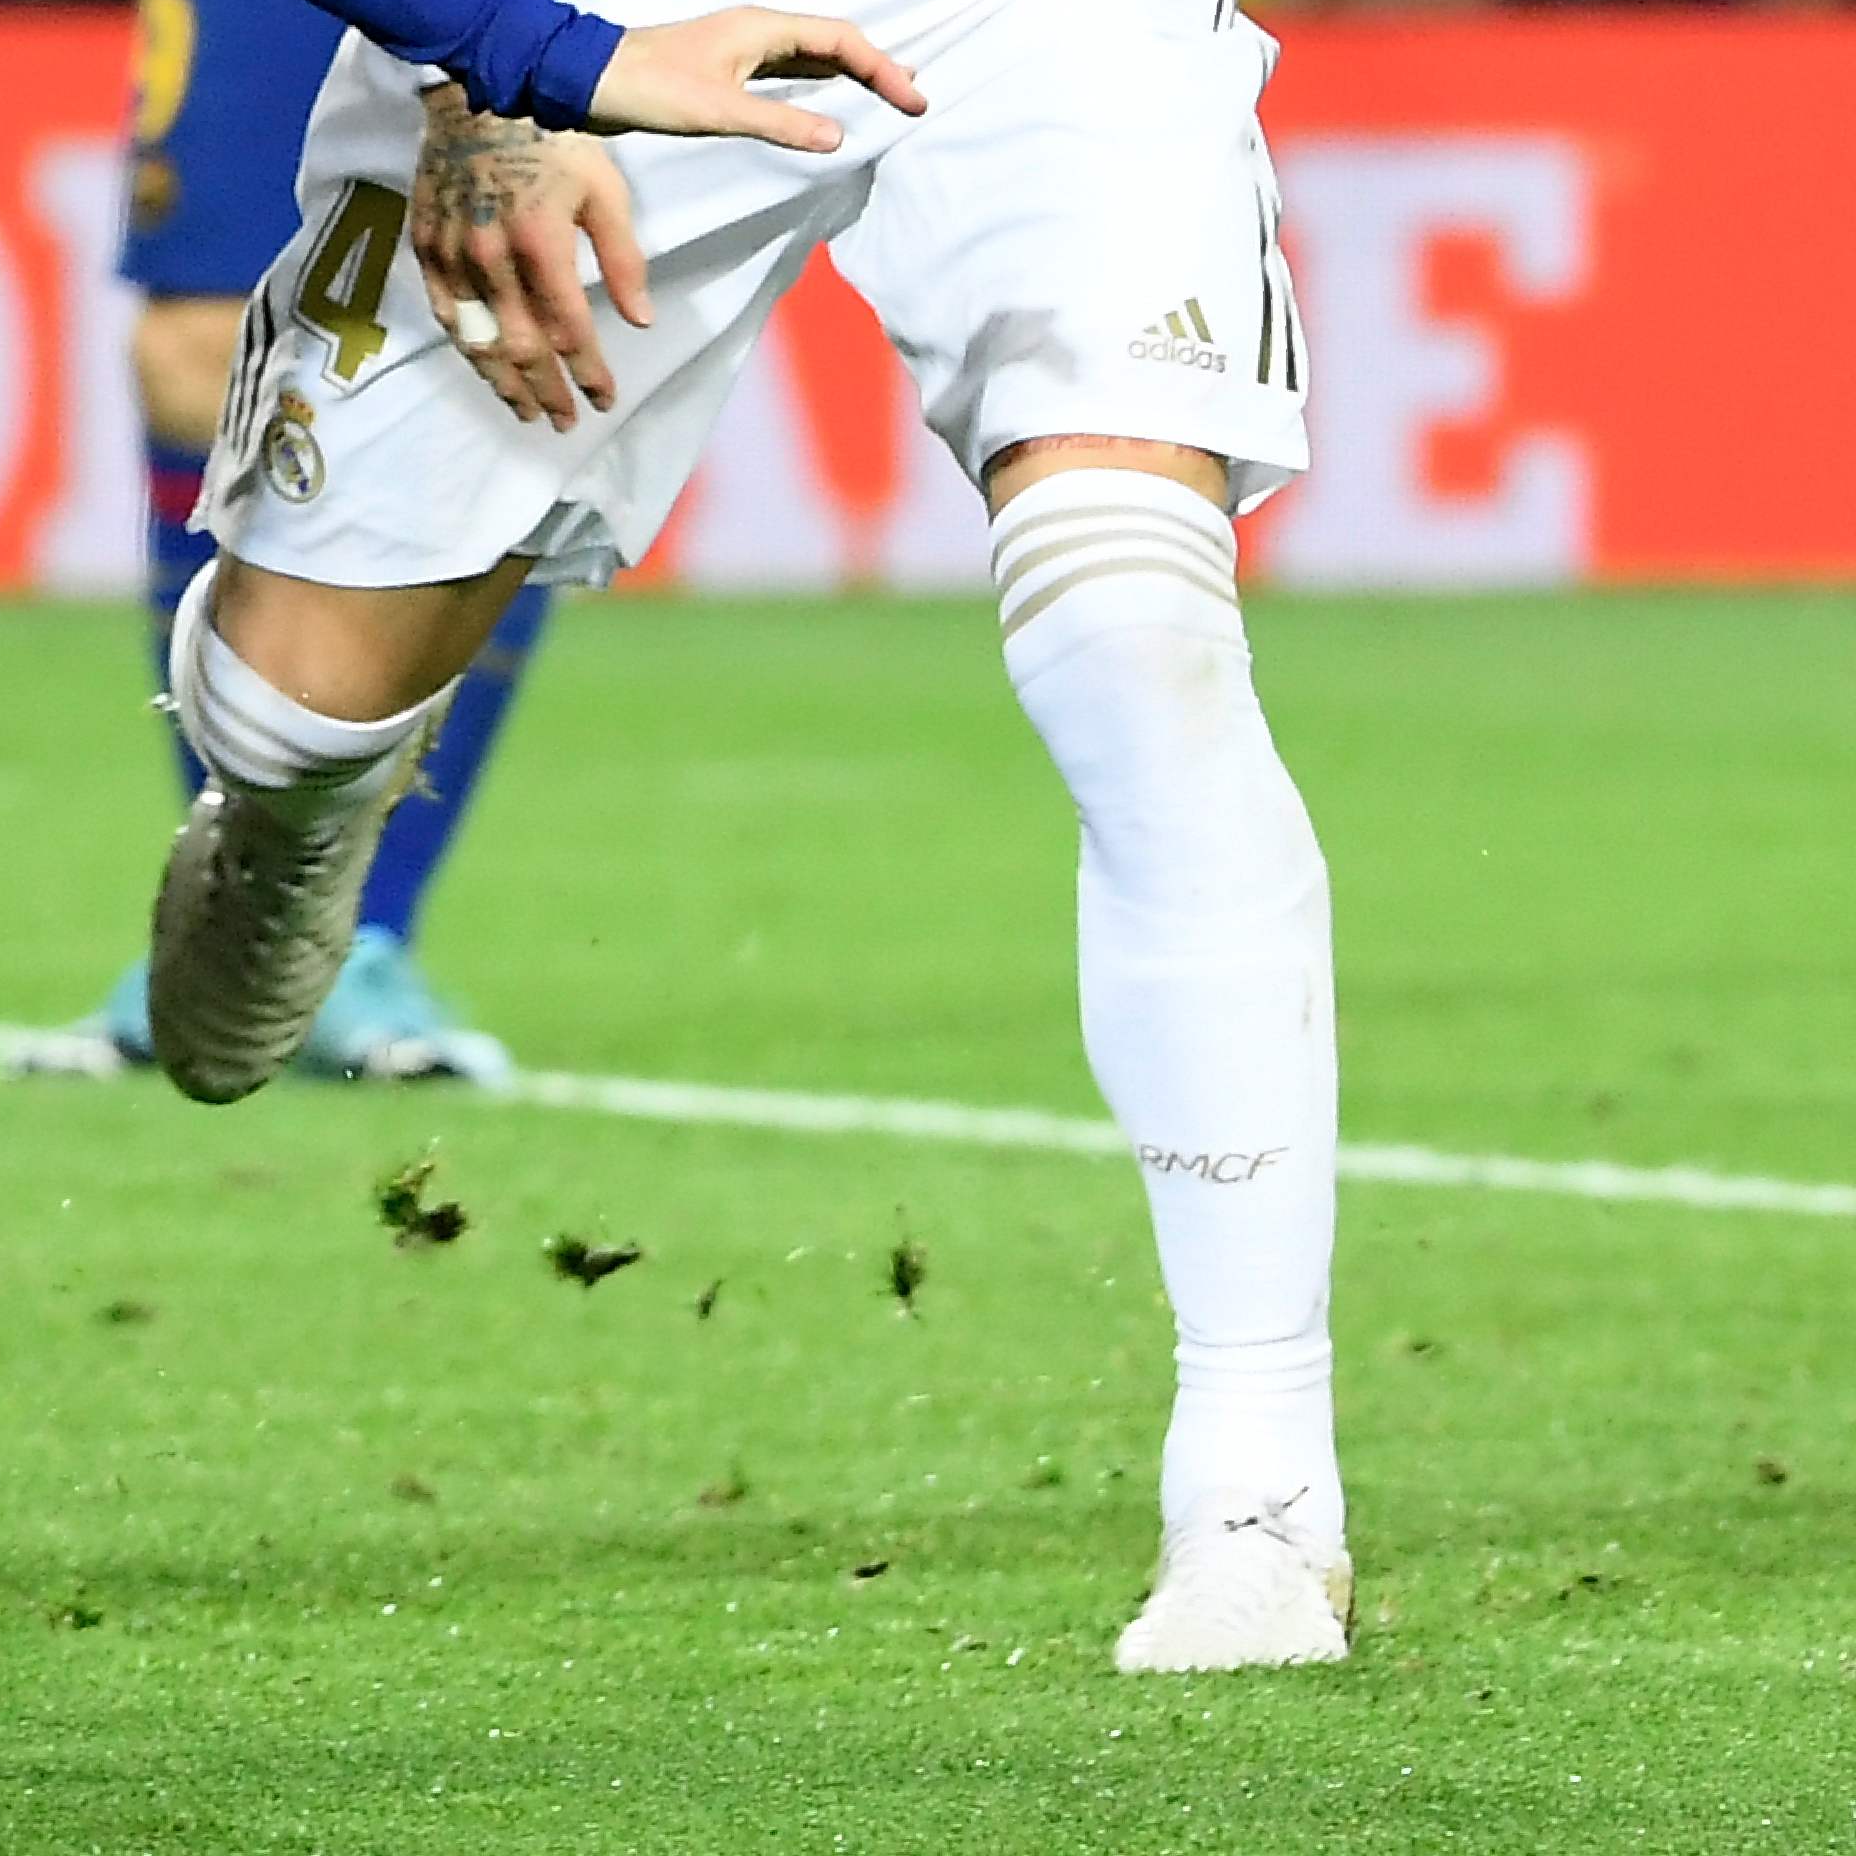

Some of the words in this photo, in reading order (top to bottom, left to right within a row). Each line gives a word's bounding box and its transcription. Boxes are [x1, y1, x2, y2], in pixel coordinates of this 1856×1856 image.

[290, 174, 410, 394] 4
[1127, 334, 1227, 374] adidas
[1139, 1143, 1290, 1184] RMCF
